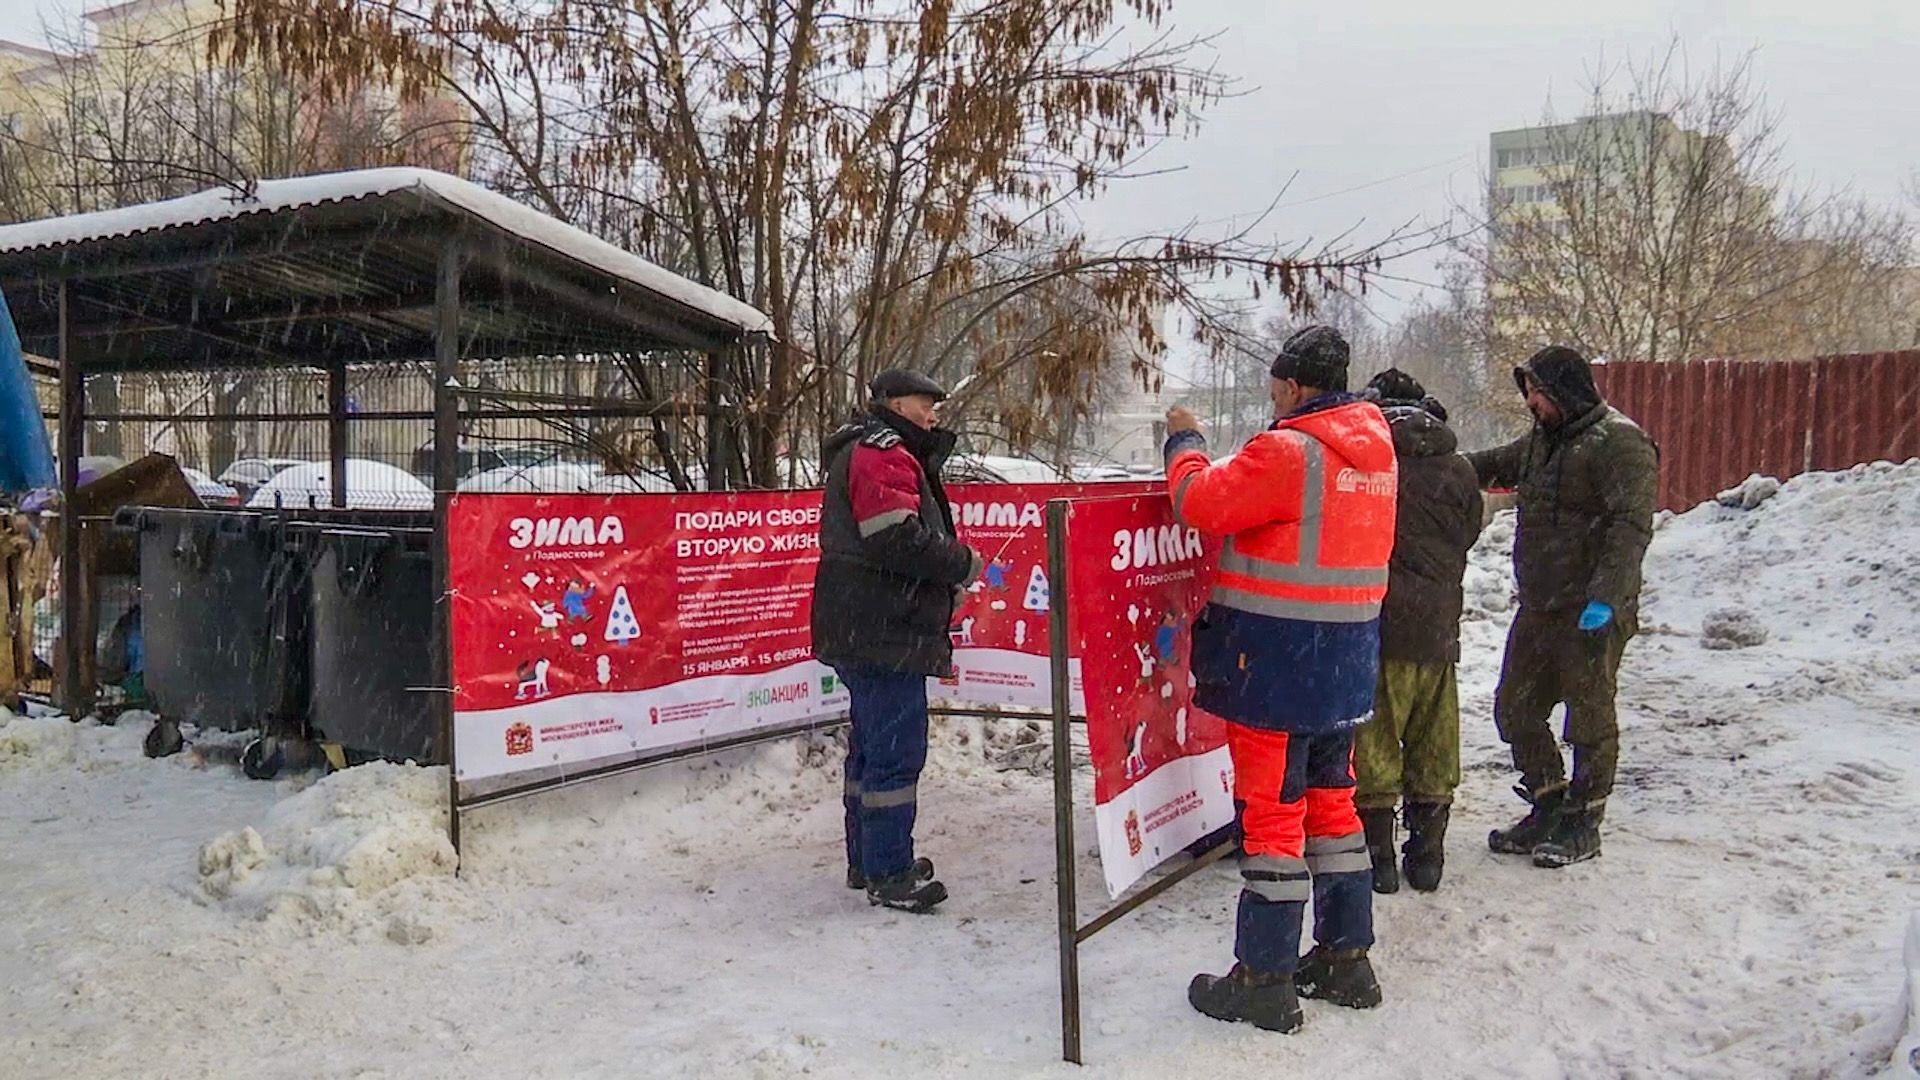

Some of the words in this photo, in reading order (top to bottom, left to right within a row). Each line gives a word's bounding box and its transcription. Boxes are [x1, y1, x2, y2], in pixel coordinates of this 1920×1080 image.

[509, 516, 624, 548] ЗИМА
[675, 510, 762, 532] ПОДАРИ
[533, 550, 605, 560] Подмосковье
[676, 536, 765, 558] ВТОРУЮ
[770, 532, 820, 552] ЖИЗН
[1110, 524, 1204, 572] ЗИМА
[682, 664, 696, 676] 15
[696, 656, 750, 673] ЯНВАРЯ
[758, 652, 772, 665] 15
[773, 646, 812, 662] ФЕВРА
[746, 682, 808, 708] ЭКОАКЦИЯ
